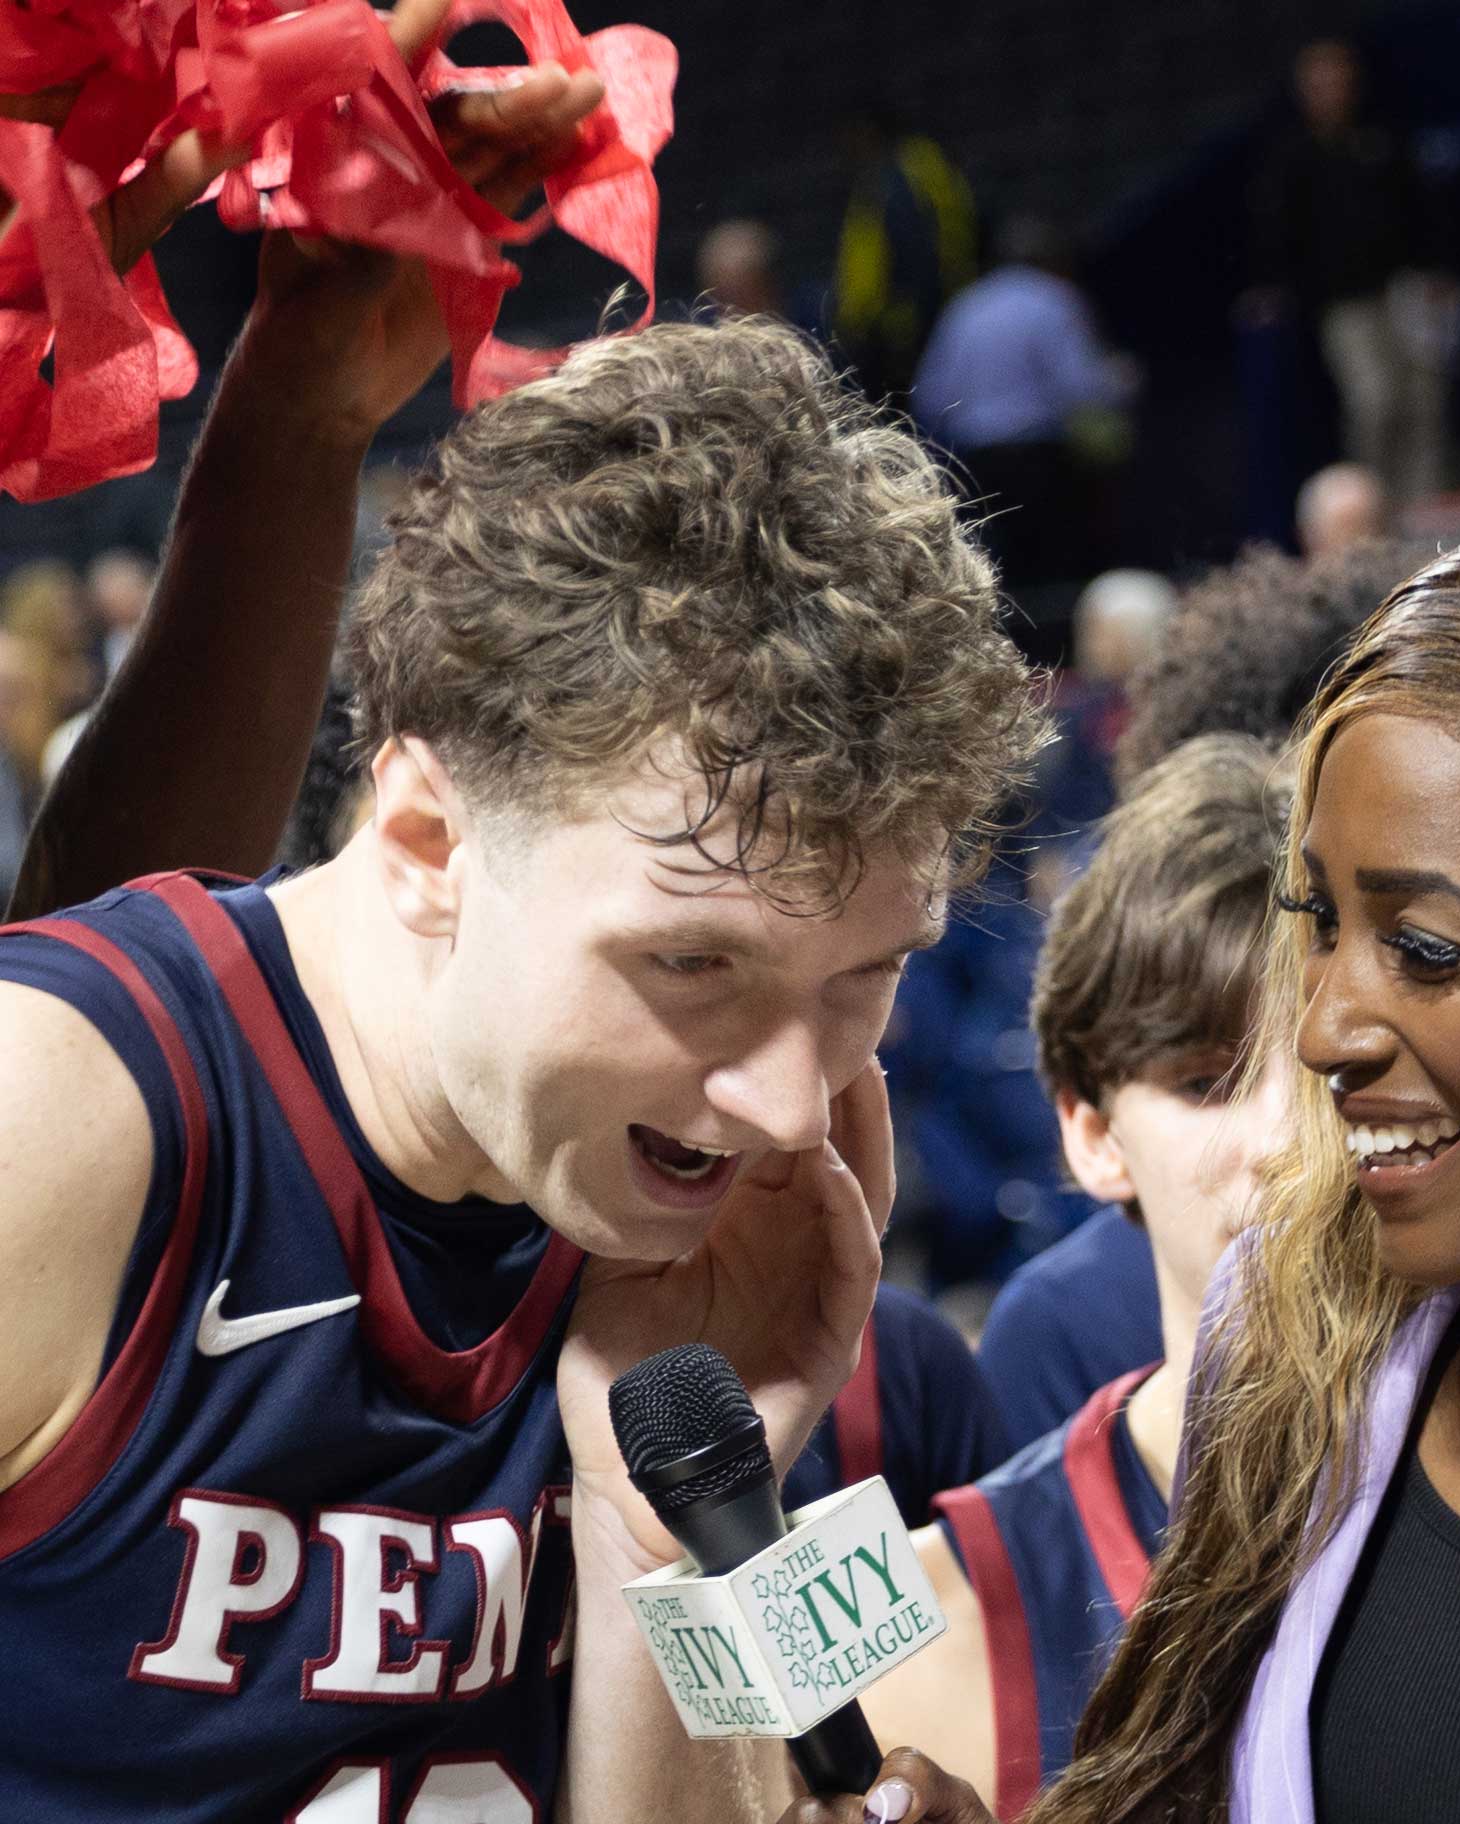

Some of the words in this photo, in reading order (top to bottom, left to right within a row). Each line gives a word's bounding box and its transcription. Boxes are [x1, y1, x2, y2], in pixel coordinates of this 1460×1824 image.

[782, 1538, 825, 1579] THE
[126, 1486, 577, 1702] PEN
[656, 1597, 688, 1620] THE
[795, 1531, 905, 1653] IVY
[671, 1625, 755, 1690] IVY
[829, 1601, 930, 1688] LEAGUE
[710, 1697, 778, 1726] LEAGUE
